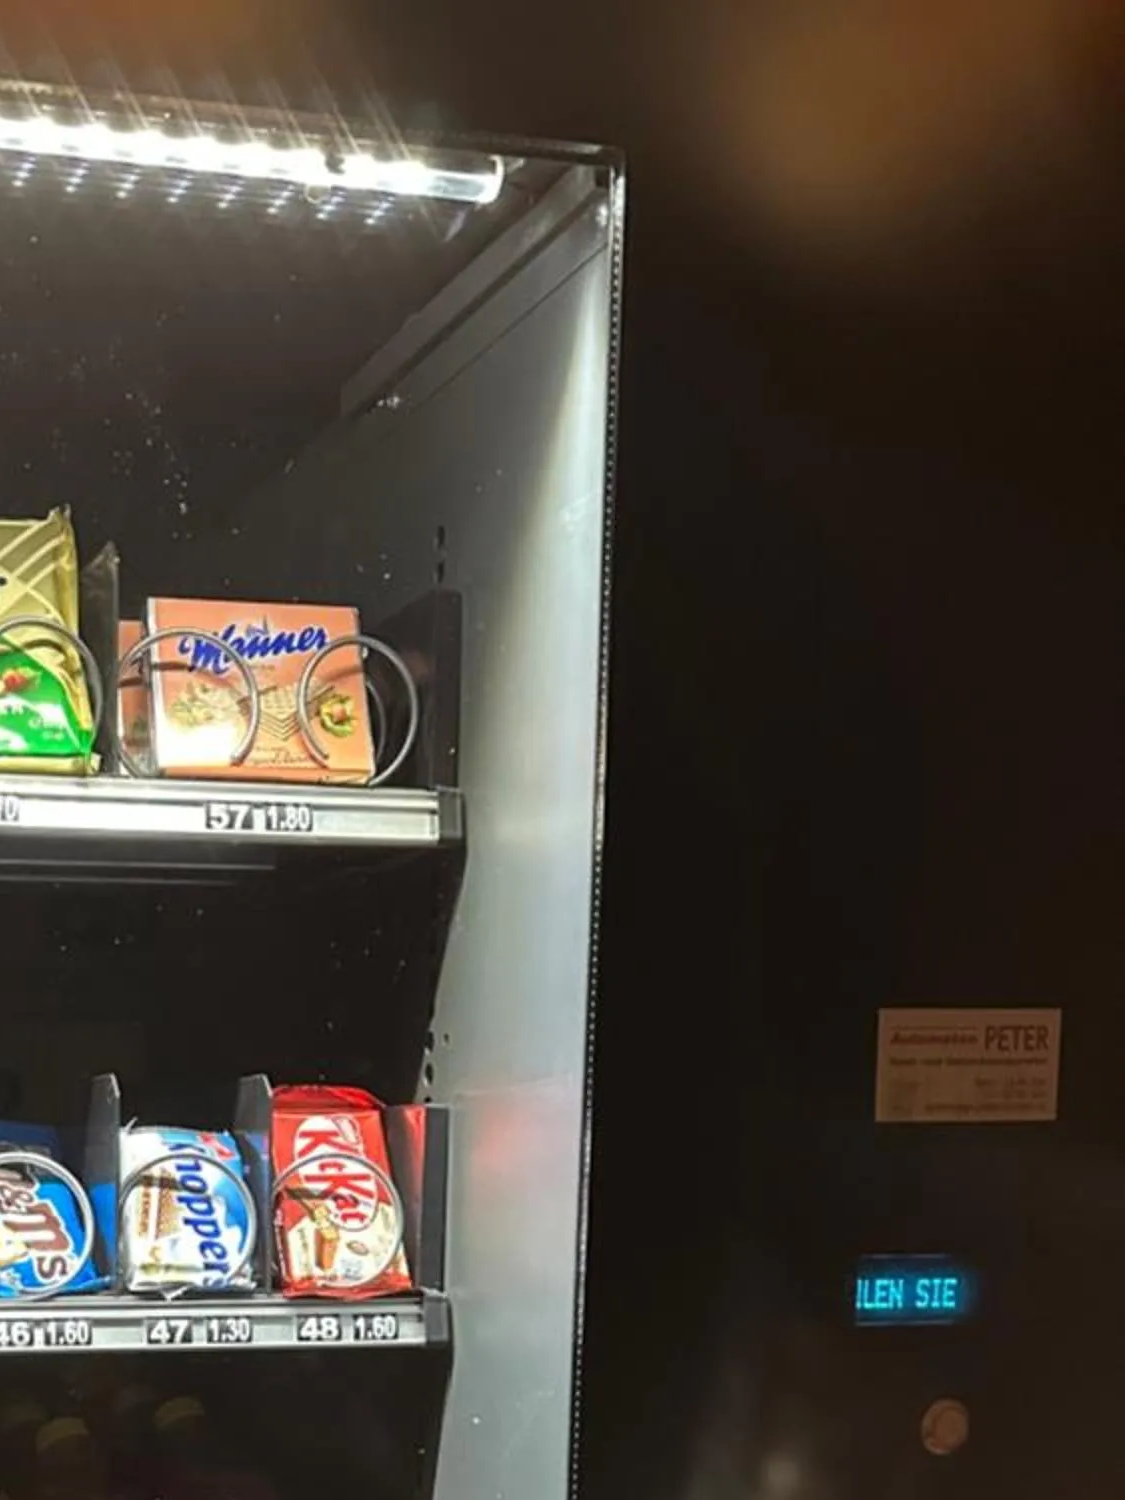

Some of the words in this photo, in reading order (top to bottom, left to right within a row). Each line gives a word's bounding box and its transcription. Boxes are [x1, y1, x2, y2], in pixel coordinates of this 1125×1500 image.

[178, 622, 327, 675] Manner
[208, 804, 253, 829] 57
[266, 806, 312, 831] 1.80
[984, 1024, 1049, 1051] PETER
[298, 1128, 373, 1224] KtKat
[915, 1278, 959, 1310] SIE
[46, 1320, 90, 1345] 1.60
[149, 1319, 191, 1344] 47
[207, 1318, 251, 1343] 1.30
[299, 1316, 340, 1341] 48
[354, 1314, 397, 1340] 1.60
